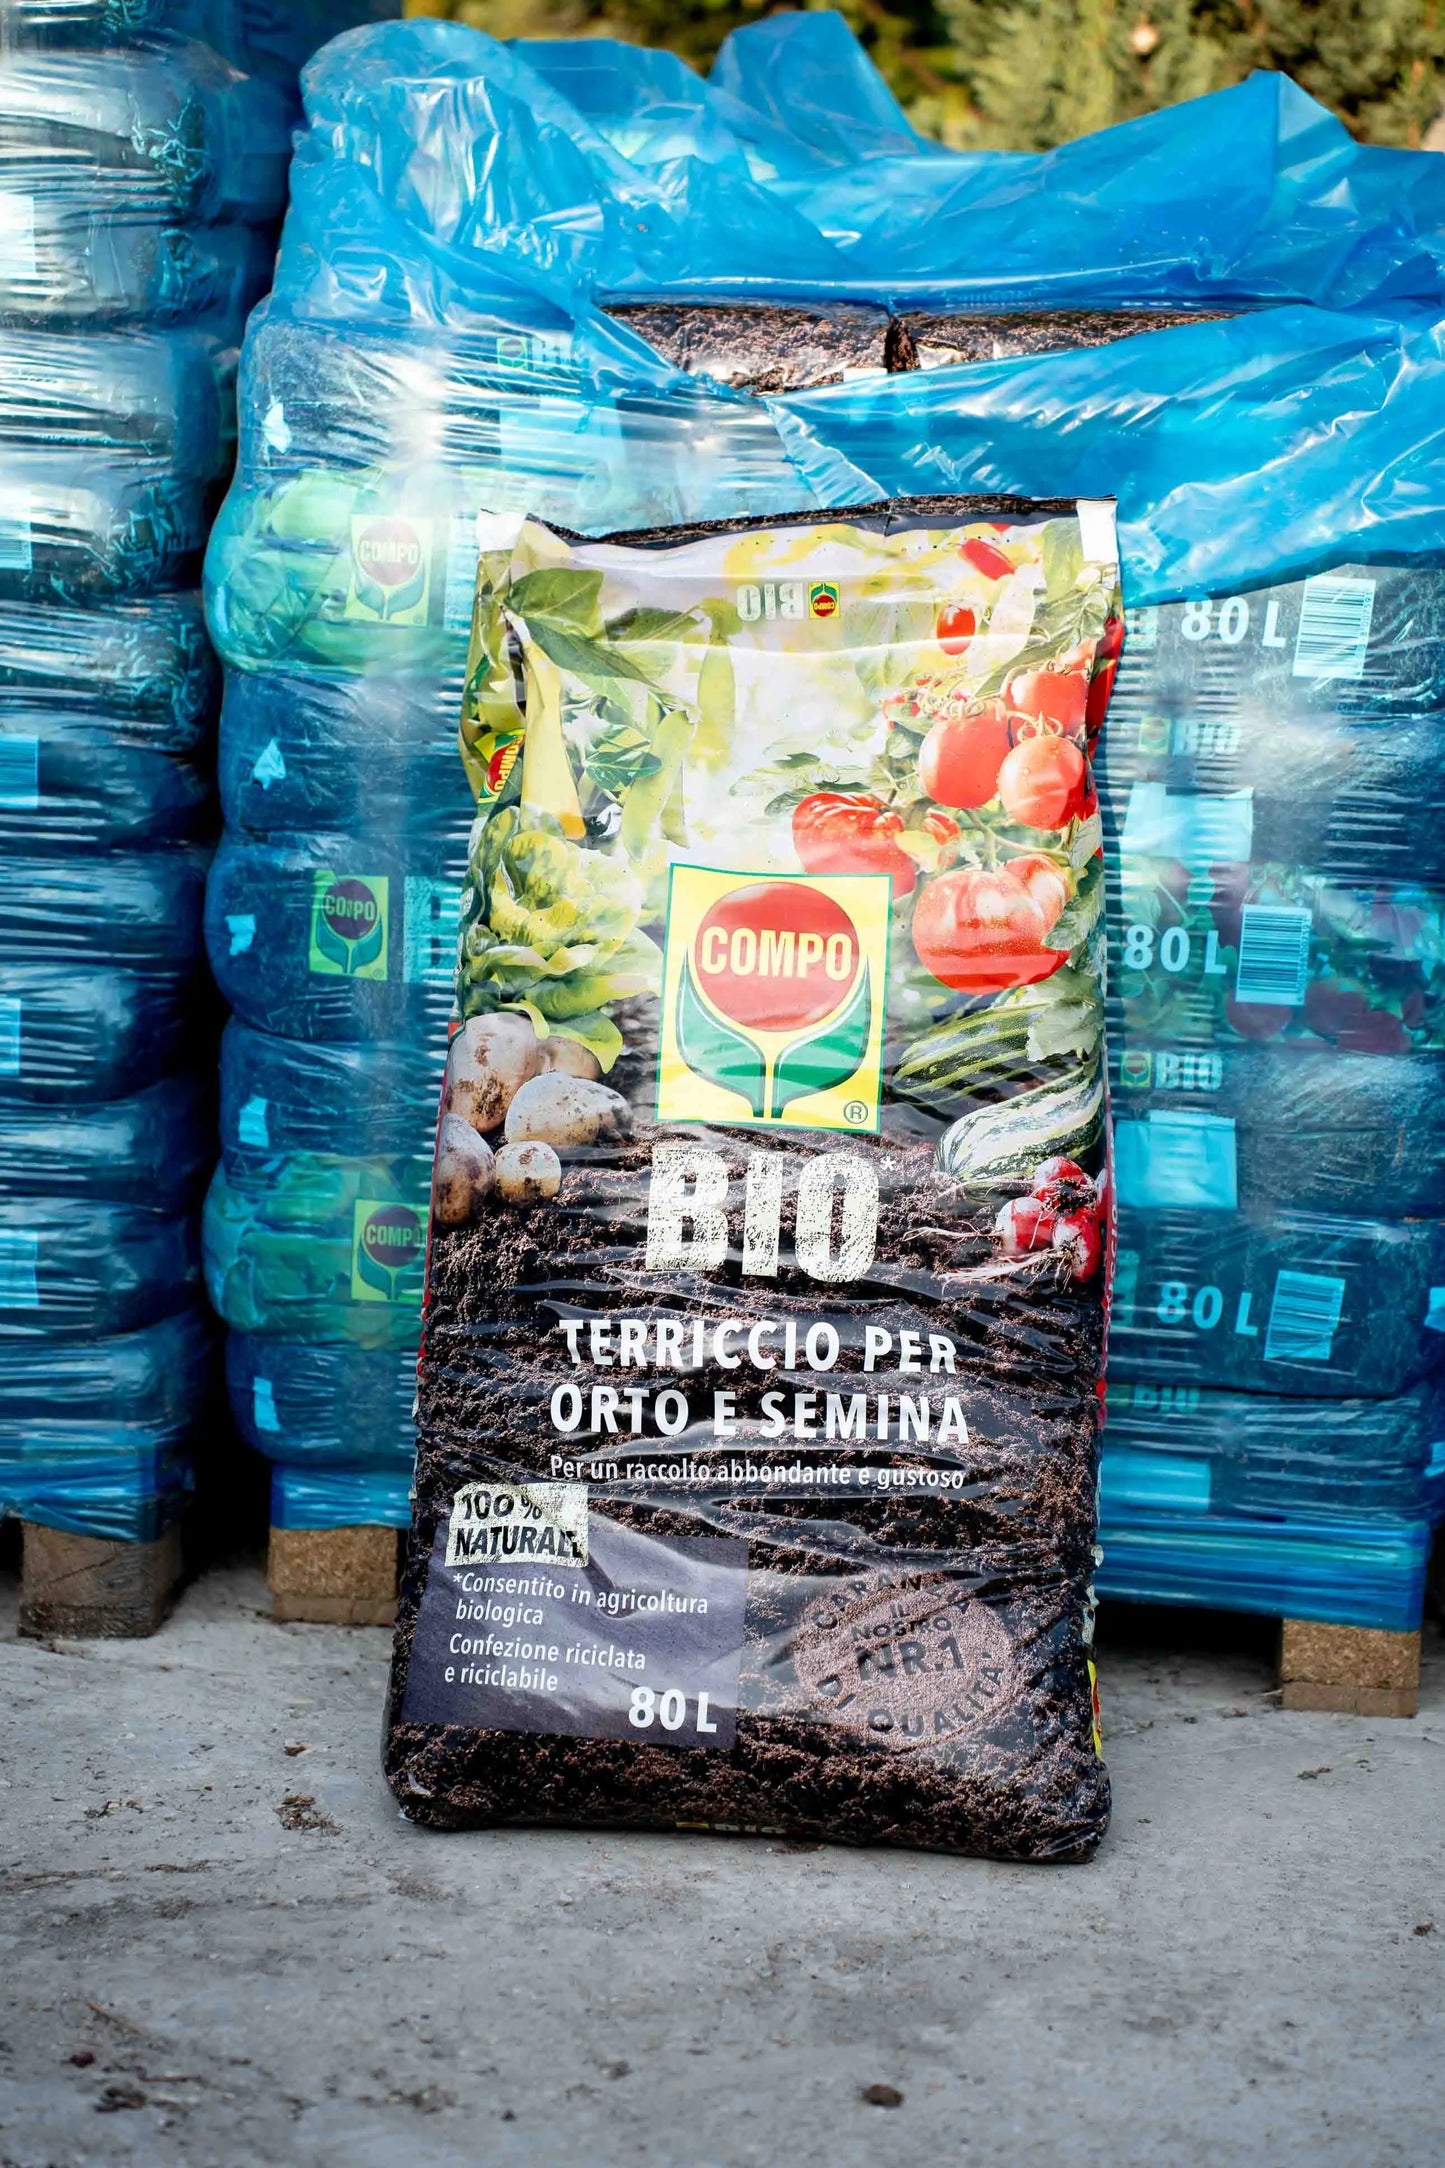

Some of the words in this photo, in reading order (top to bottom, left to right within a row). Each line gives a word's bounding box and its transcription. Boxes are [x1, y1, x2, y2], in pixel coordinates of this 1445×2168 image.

[737, 583, 804, 621] BIO
[1181, 593, 1250, 645] 80
[1262, 600, 1287, 648] L
[701, 926, 852, 982] COMPO
[1124, 924, 1190, 972] 80
[1204, 930, 1227, 974] L
[1157, 1281, 1223, 1330] 80
[1234, 1292, 1258, 1336] L
[559, 1319, 840, 1372] TERRICCIO
[864, 1325, 957, 1375] PER
[550, 1383, 689, 1436] ORTO
[713, 1391, 737, 1436] E
[759, 1391, 970, 1444] SEMINA
[550, 1455, 584, 1479] Per
[591, 1460, 618, 1480] un
[626, 1457, 710, 1481] raccolto
[717, 1460, 852, 1486] abbondante
[858, 1469, 870, 1486] e
[876, 1468, 964, 1491] gustoso
[461, 1490, 515, 1520] 100
[520, 1493, 543, 1520] %
[455, 1598, 544, 1628] biologica
[571, 1583, 591, 1606] in
[597, 1589, 708, 1615] agricoltura
[449, 1632, 559, 1662] Confezione
[565, 1642, 646, 1670] riciclata
[444, 1666, 456, 1683] e
[460, 1662, 558, 1691] riciclabile
[628, 1686, 687, 1732] 80
[696, 1691, 718, 1733] L
